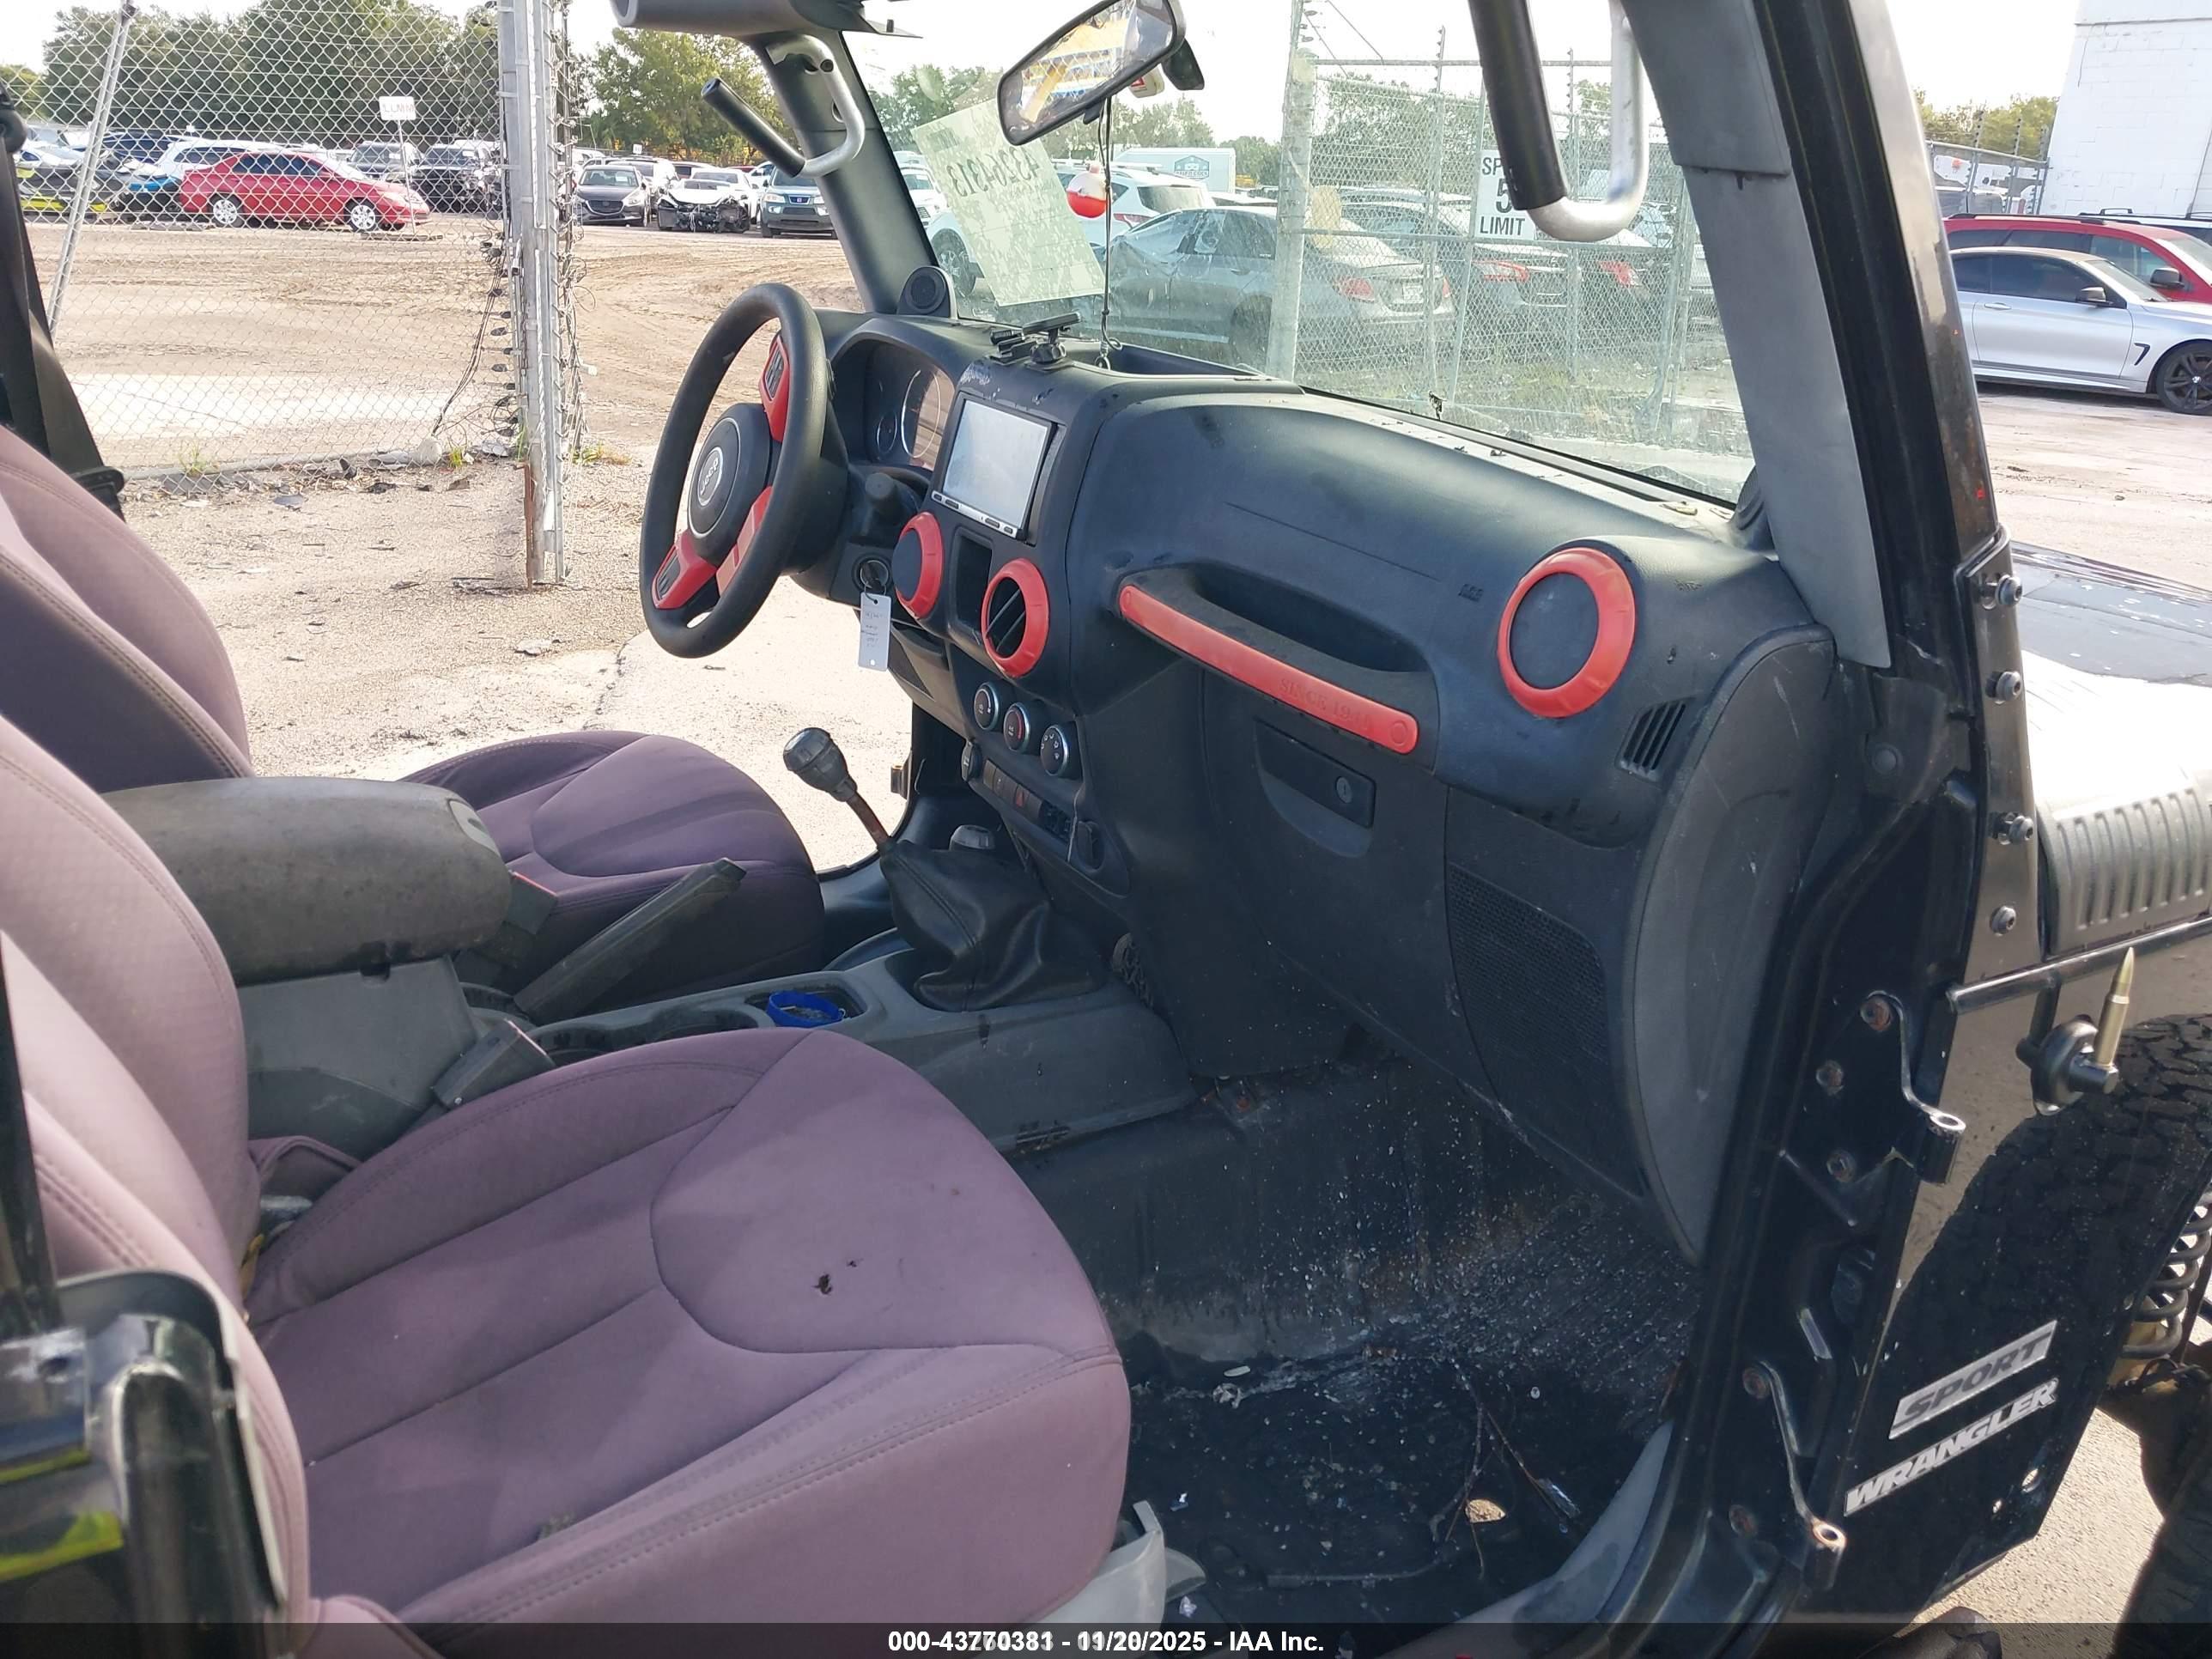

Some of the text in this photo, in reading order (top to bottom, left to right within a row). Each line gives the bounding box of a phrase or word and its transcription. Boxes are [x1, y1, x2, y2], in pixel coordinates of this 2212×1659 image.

[1480, 216, 1525, 235] LIMIT
[1279, 678, 1328, 711] SINCE
[1899, 1332, 2052, 1421] SPORT
[1844, 1377, 2060, 1516] WRANGLER
